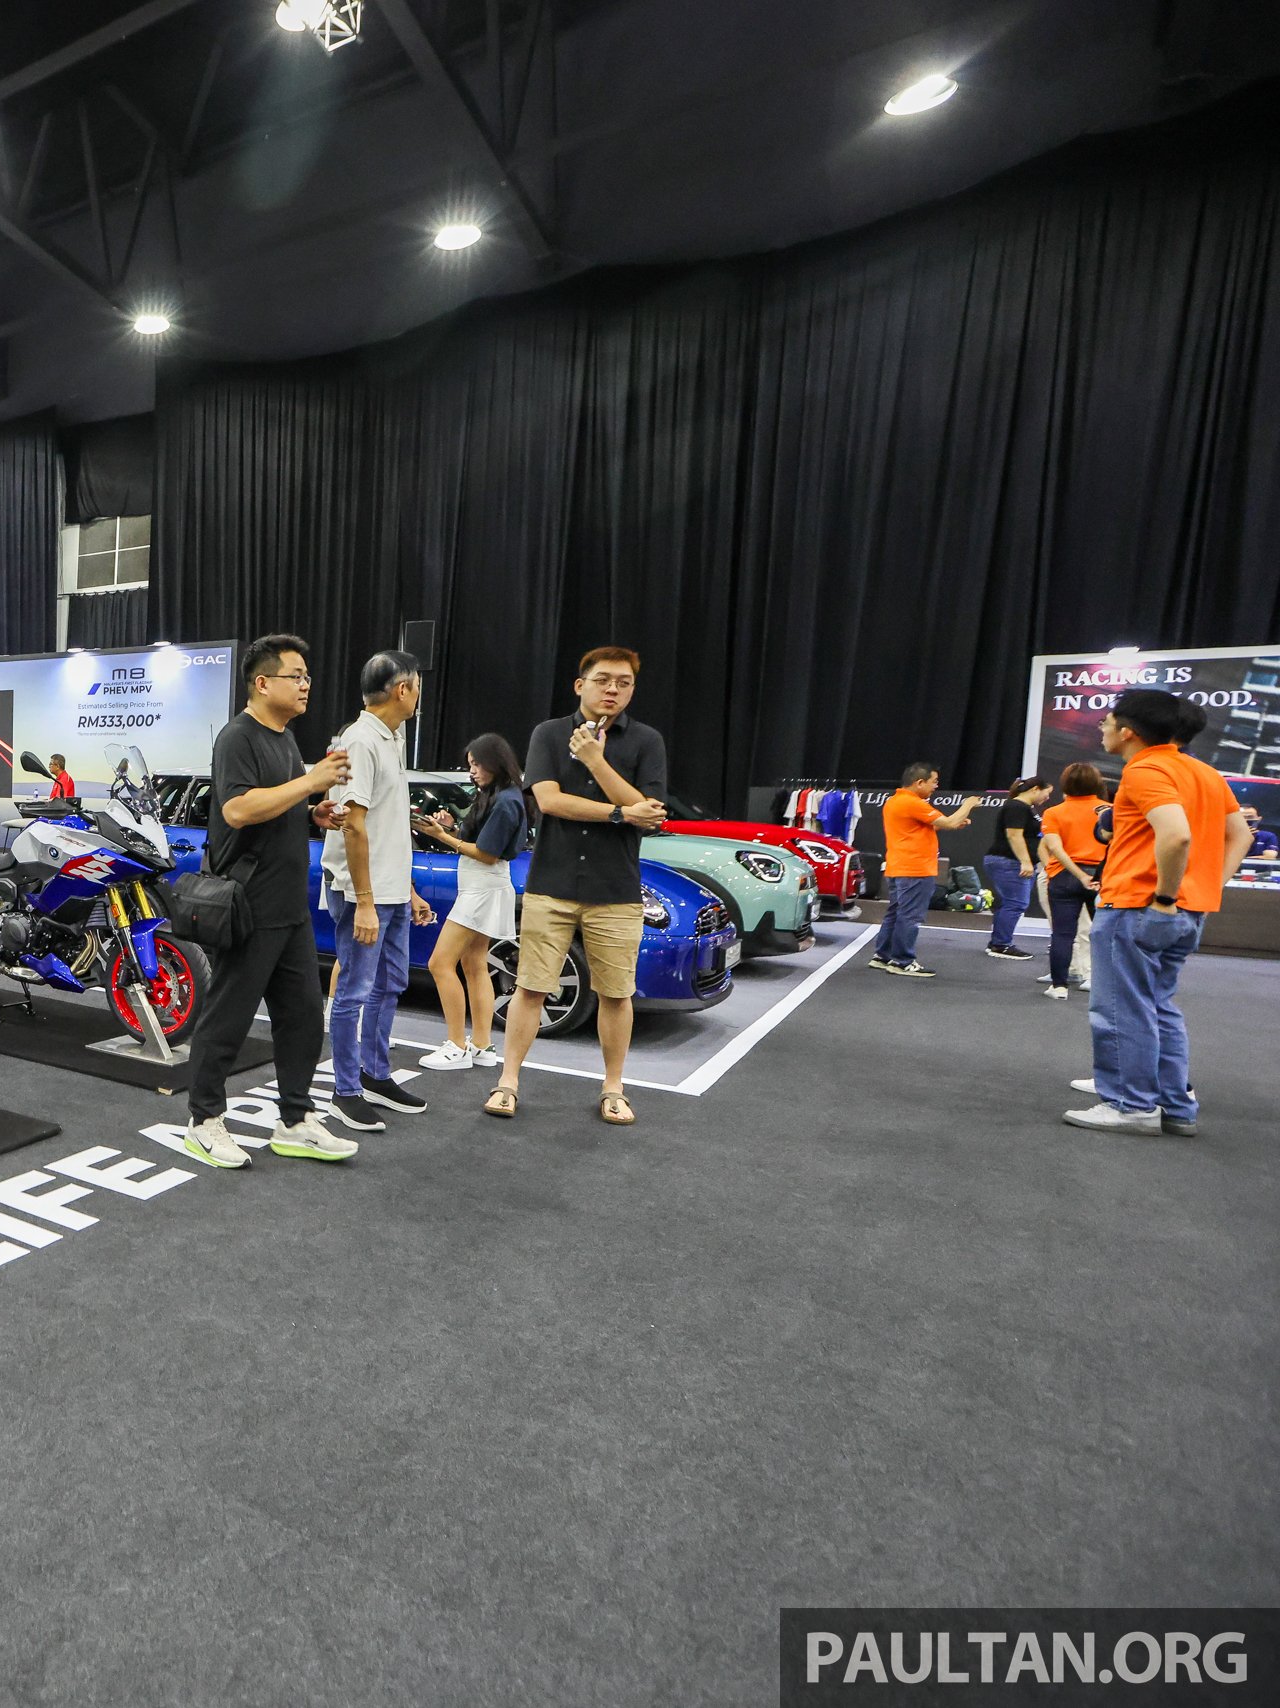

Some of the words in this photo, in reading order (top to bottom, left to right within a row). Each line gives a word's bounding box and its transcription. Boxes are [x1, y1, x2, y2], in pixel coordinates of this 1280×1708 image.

[192, 654, 227, 665] GAC
[1054, 667, 1158, 687] RACING
[1163, 666, 1193, 684] IS
[103, 686, 128, 695] PHEV
[130, 685, 152, 694] MPV
[108, 702, 128, 710] Selling
[1052, 694, 1084, 711] IN
